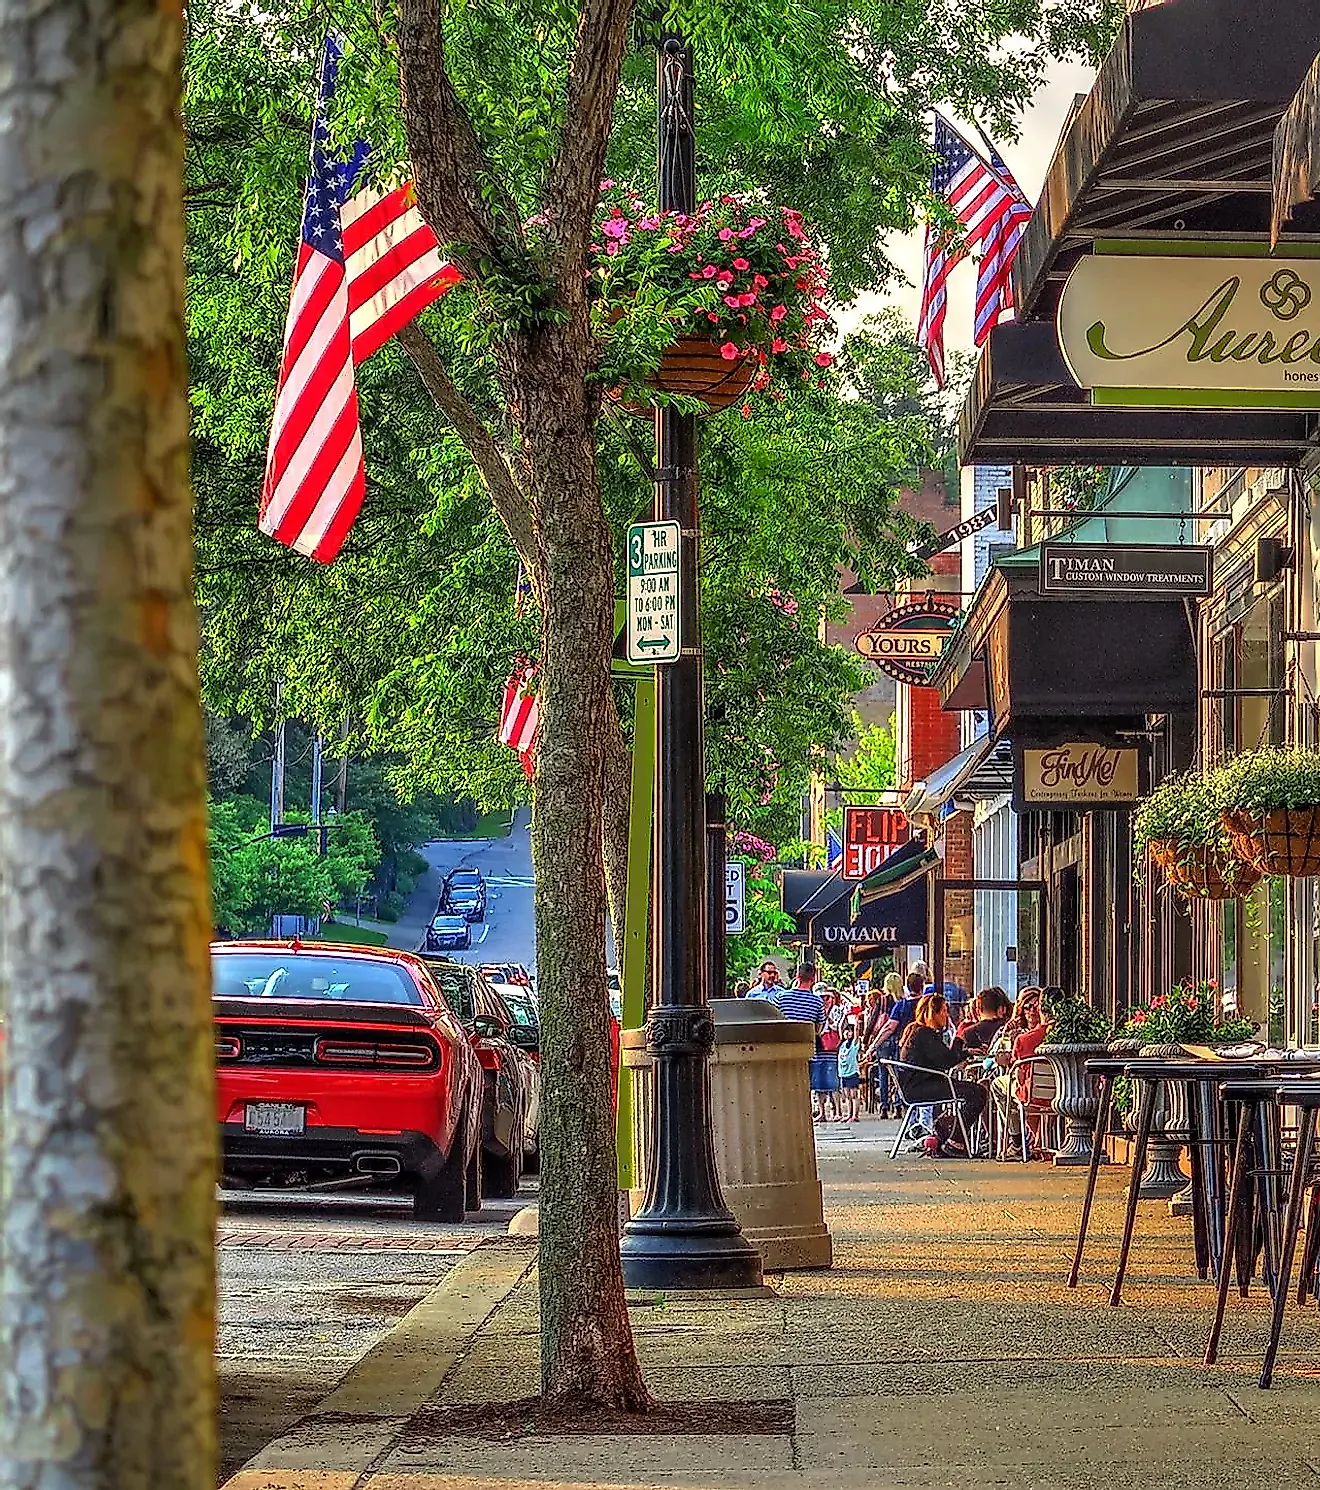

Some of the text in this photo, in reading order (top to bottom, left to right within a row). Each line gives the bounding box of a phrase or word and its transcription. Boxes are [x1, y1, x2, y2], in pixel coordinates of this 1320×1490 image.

[948, 510, 996, 542] 1981
[653, 530, 668, 548] HR
[631, 535, 641, 569] 3
[644, 550, 677, 570] PARKING
[1049, 557, 1116, 581] TIMAN
[1065, 572, 1205, 584] CUSTOM WINDOW TREATMENTS
[640, 576, 670, 594] 9:00 AM
[634, 594, 676, 613] TO 6:00 PM
[636, 616, 653, 632] MON
[660, 614, 674, 630] SAT
[906, 661, 938, 669] RESTAU
[1040, 749, 1122, 787] Find Me!
[850, 810, 908, 843] FLIP
[823, 926, 897, 942] UMAMI
